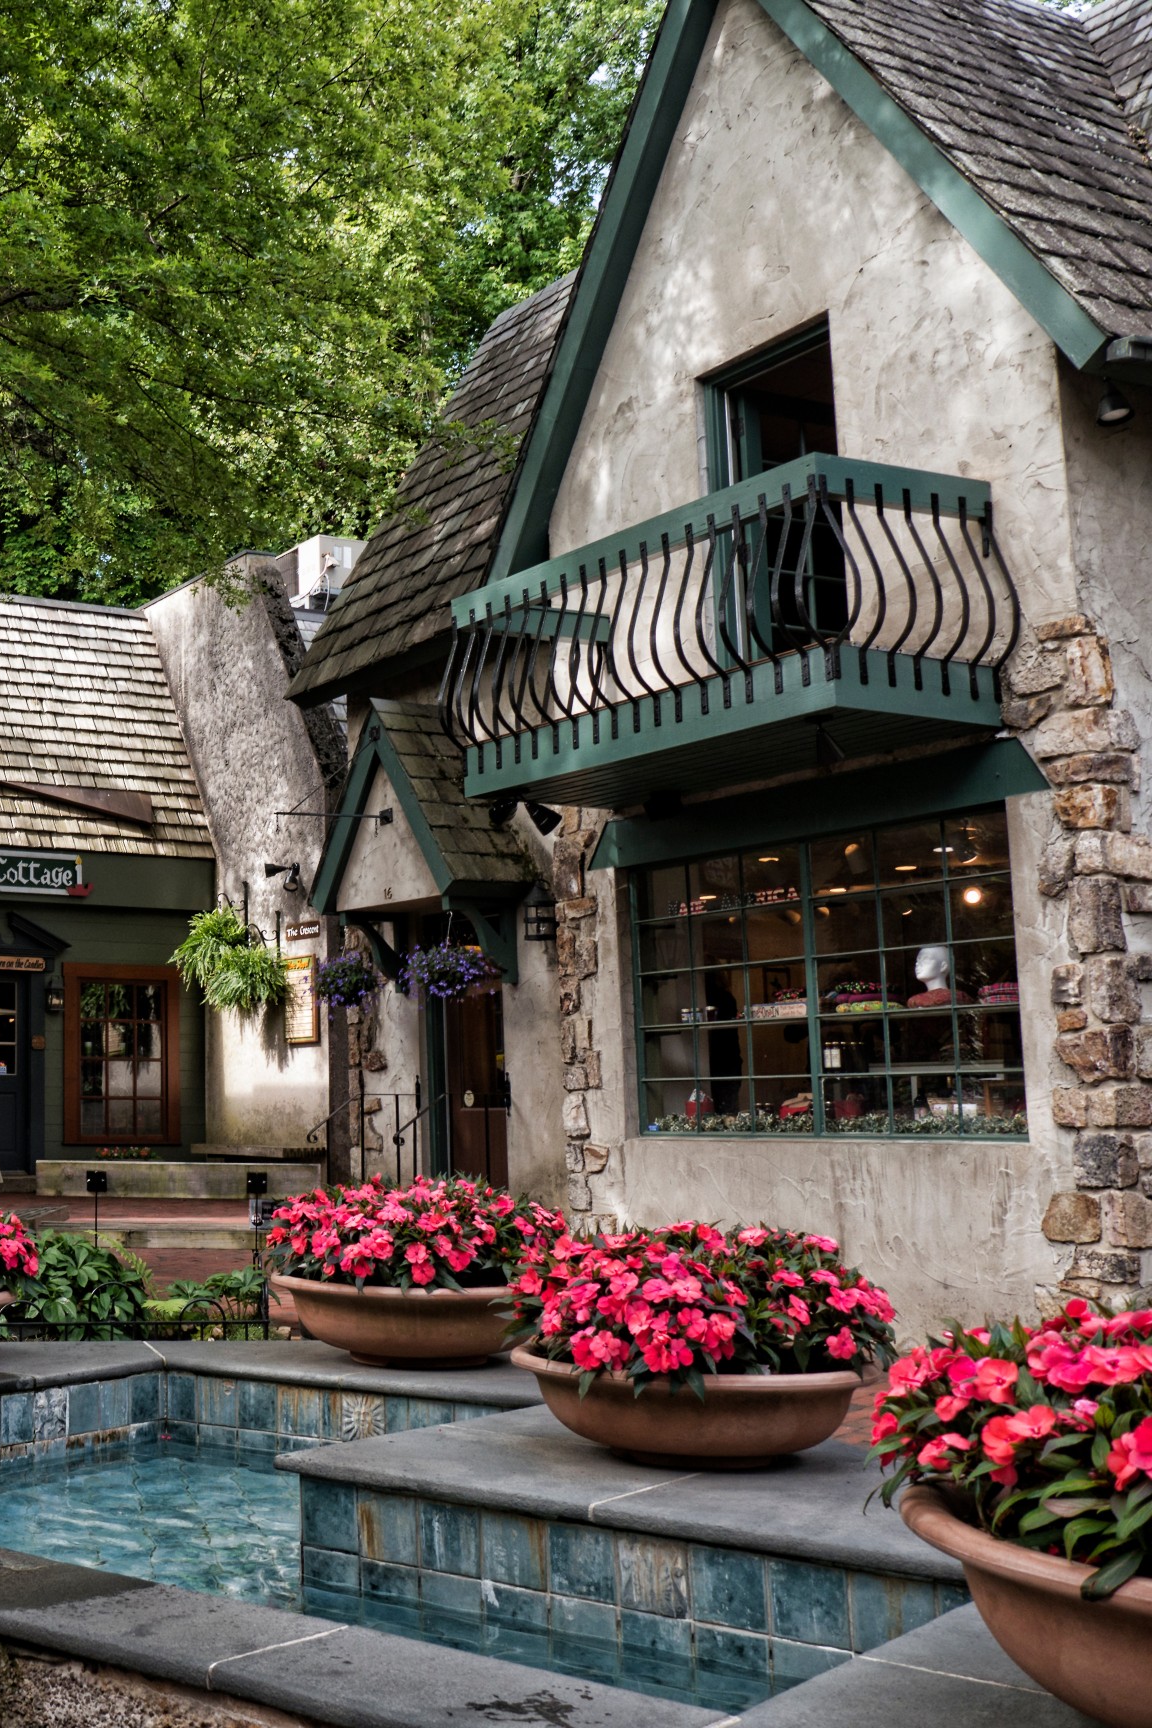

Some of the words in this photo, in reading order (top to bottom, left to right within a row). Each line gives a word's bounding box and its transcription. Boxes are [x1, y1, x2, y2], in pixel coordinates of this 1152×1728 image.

[287, 928, 298, 937] The
[300, 925, 318, 936] Crescent
[15, 959, 24, 969] the
[24, 960, 43, 970] Candles
